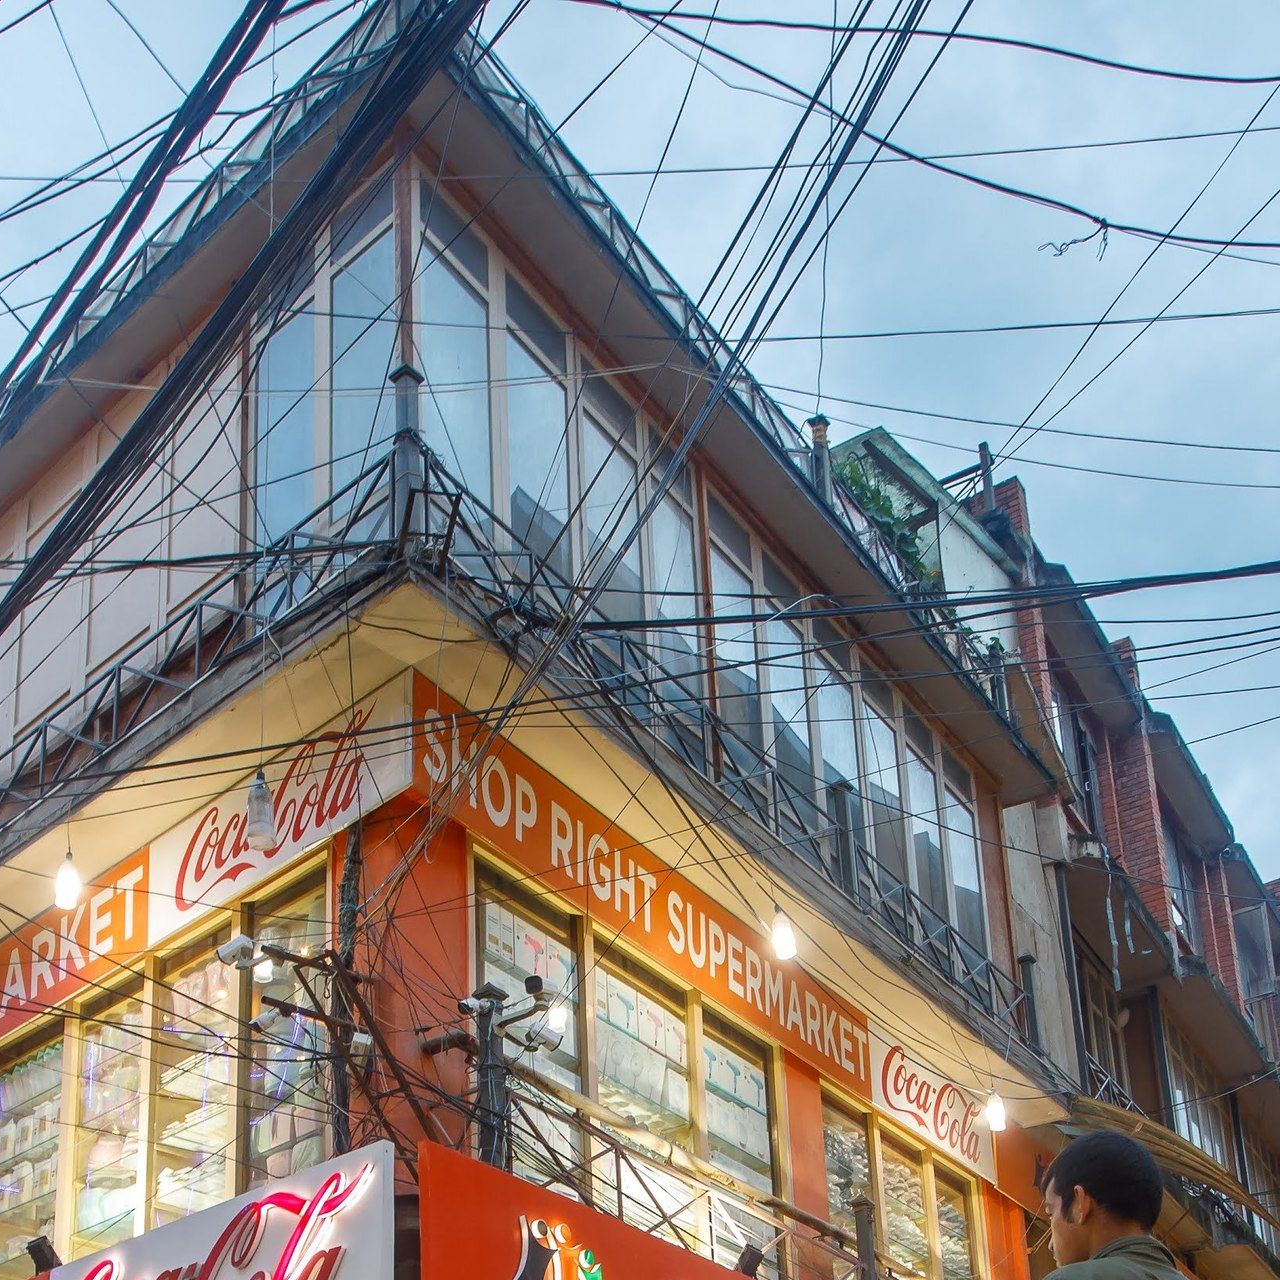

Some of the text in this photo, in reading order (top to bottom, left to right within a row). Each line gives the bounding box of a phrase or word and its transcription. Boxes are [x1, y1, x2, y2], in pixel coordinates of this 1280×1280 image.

[422, 708, 868, 1082] SHOP RIGHT SUPERMARKET
[881, 1045, 982, 1165] Coca-Cola
